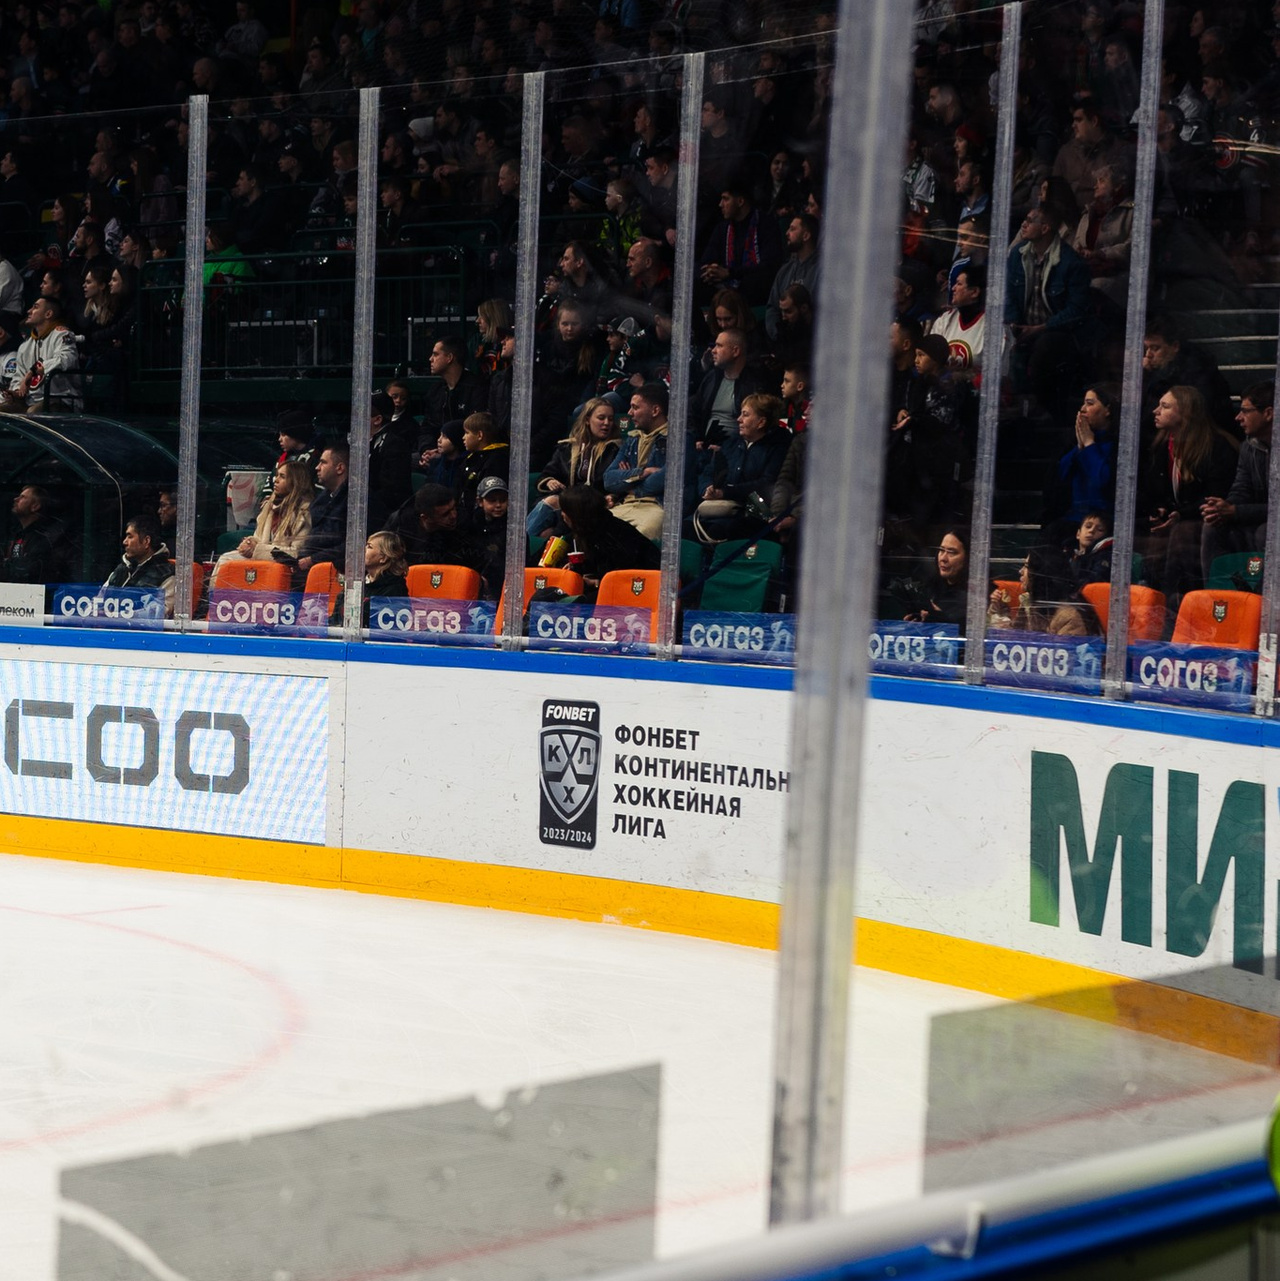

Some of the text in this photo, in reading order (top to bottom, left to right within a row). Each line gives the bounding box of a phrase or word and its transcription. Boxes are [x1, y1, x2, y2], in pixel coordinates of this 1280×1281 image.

[870, 632, 926, 662] огаз
[545, 704, 596, 723] FONBET
[615, 724, 700, 751] ФОНБЕТ
[614, 753, 792, 793] КОНТИНЕНТАЛЬН
[612, 784, 741, 818] ХОККЕЙНАЯ
[543, 827, 593, 844] 2023/2024
[612, 813, 667, 839] ЛИГА
[1030, 750, 1280, 981] МИ
